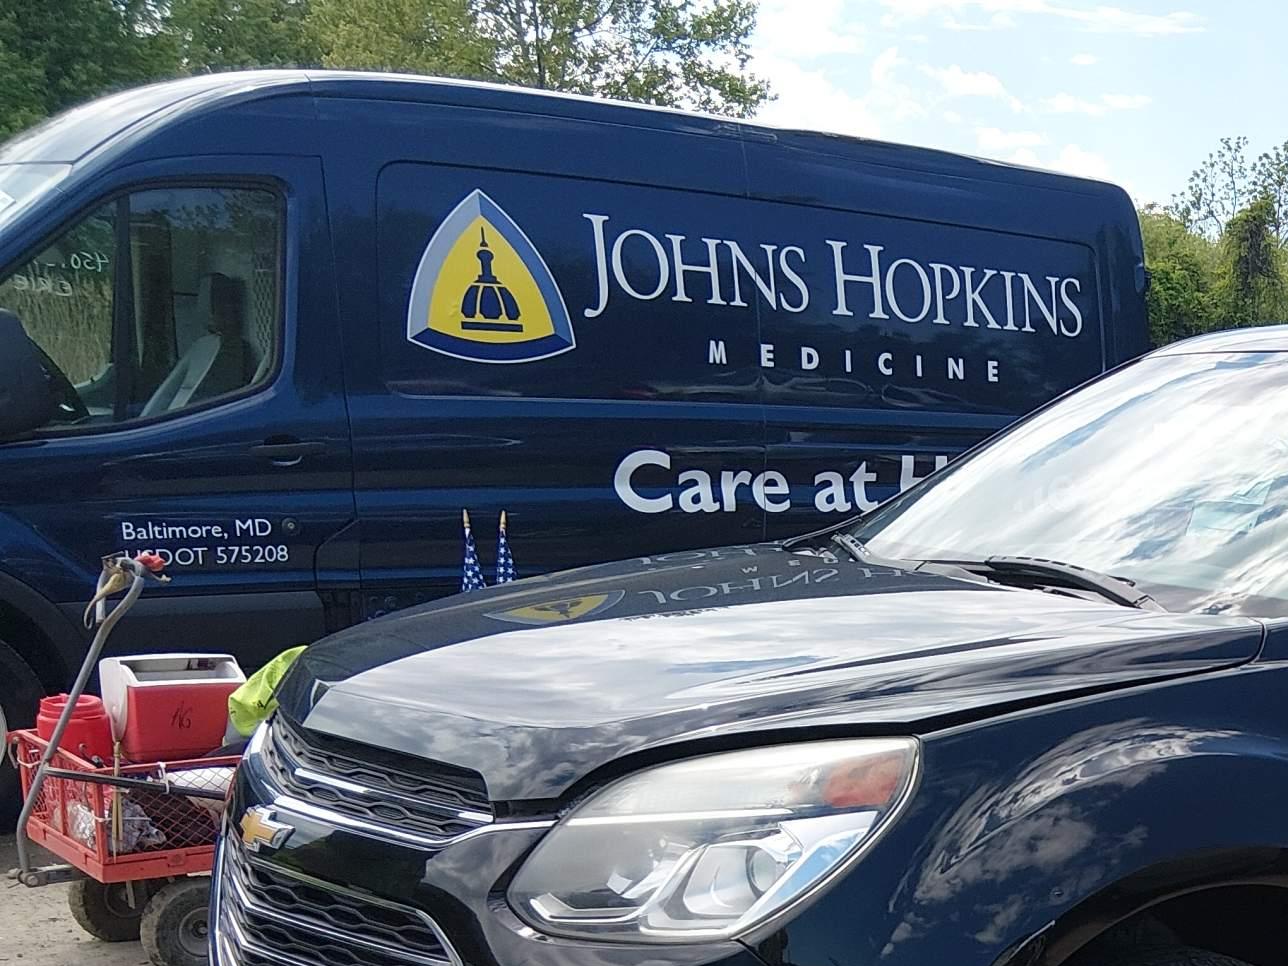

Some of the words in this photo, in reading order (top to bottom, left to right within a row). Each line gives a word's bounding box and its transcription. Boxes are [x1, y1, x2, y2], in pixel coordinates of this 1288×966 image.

[583, 213, 809, 318] JOHNS
[825, 240, 1083, 337] HOPKINS
[709, 340, 999, 383] MEDICINE
[614, 449, 790, 513] Care
[814, 460, 879, 513] at
[121, 521, 229, 540] Baltimore,
[235, 518, 272, 537] MD
[216, 545, 289, 564] 575208
